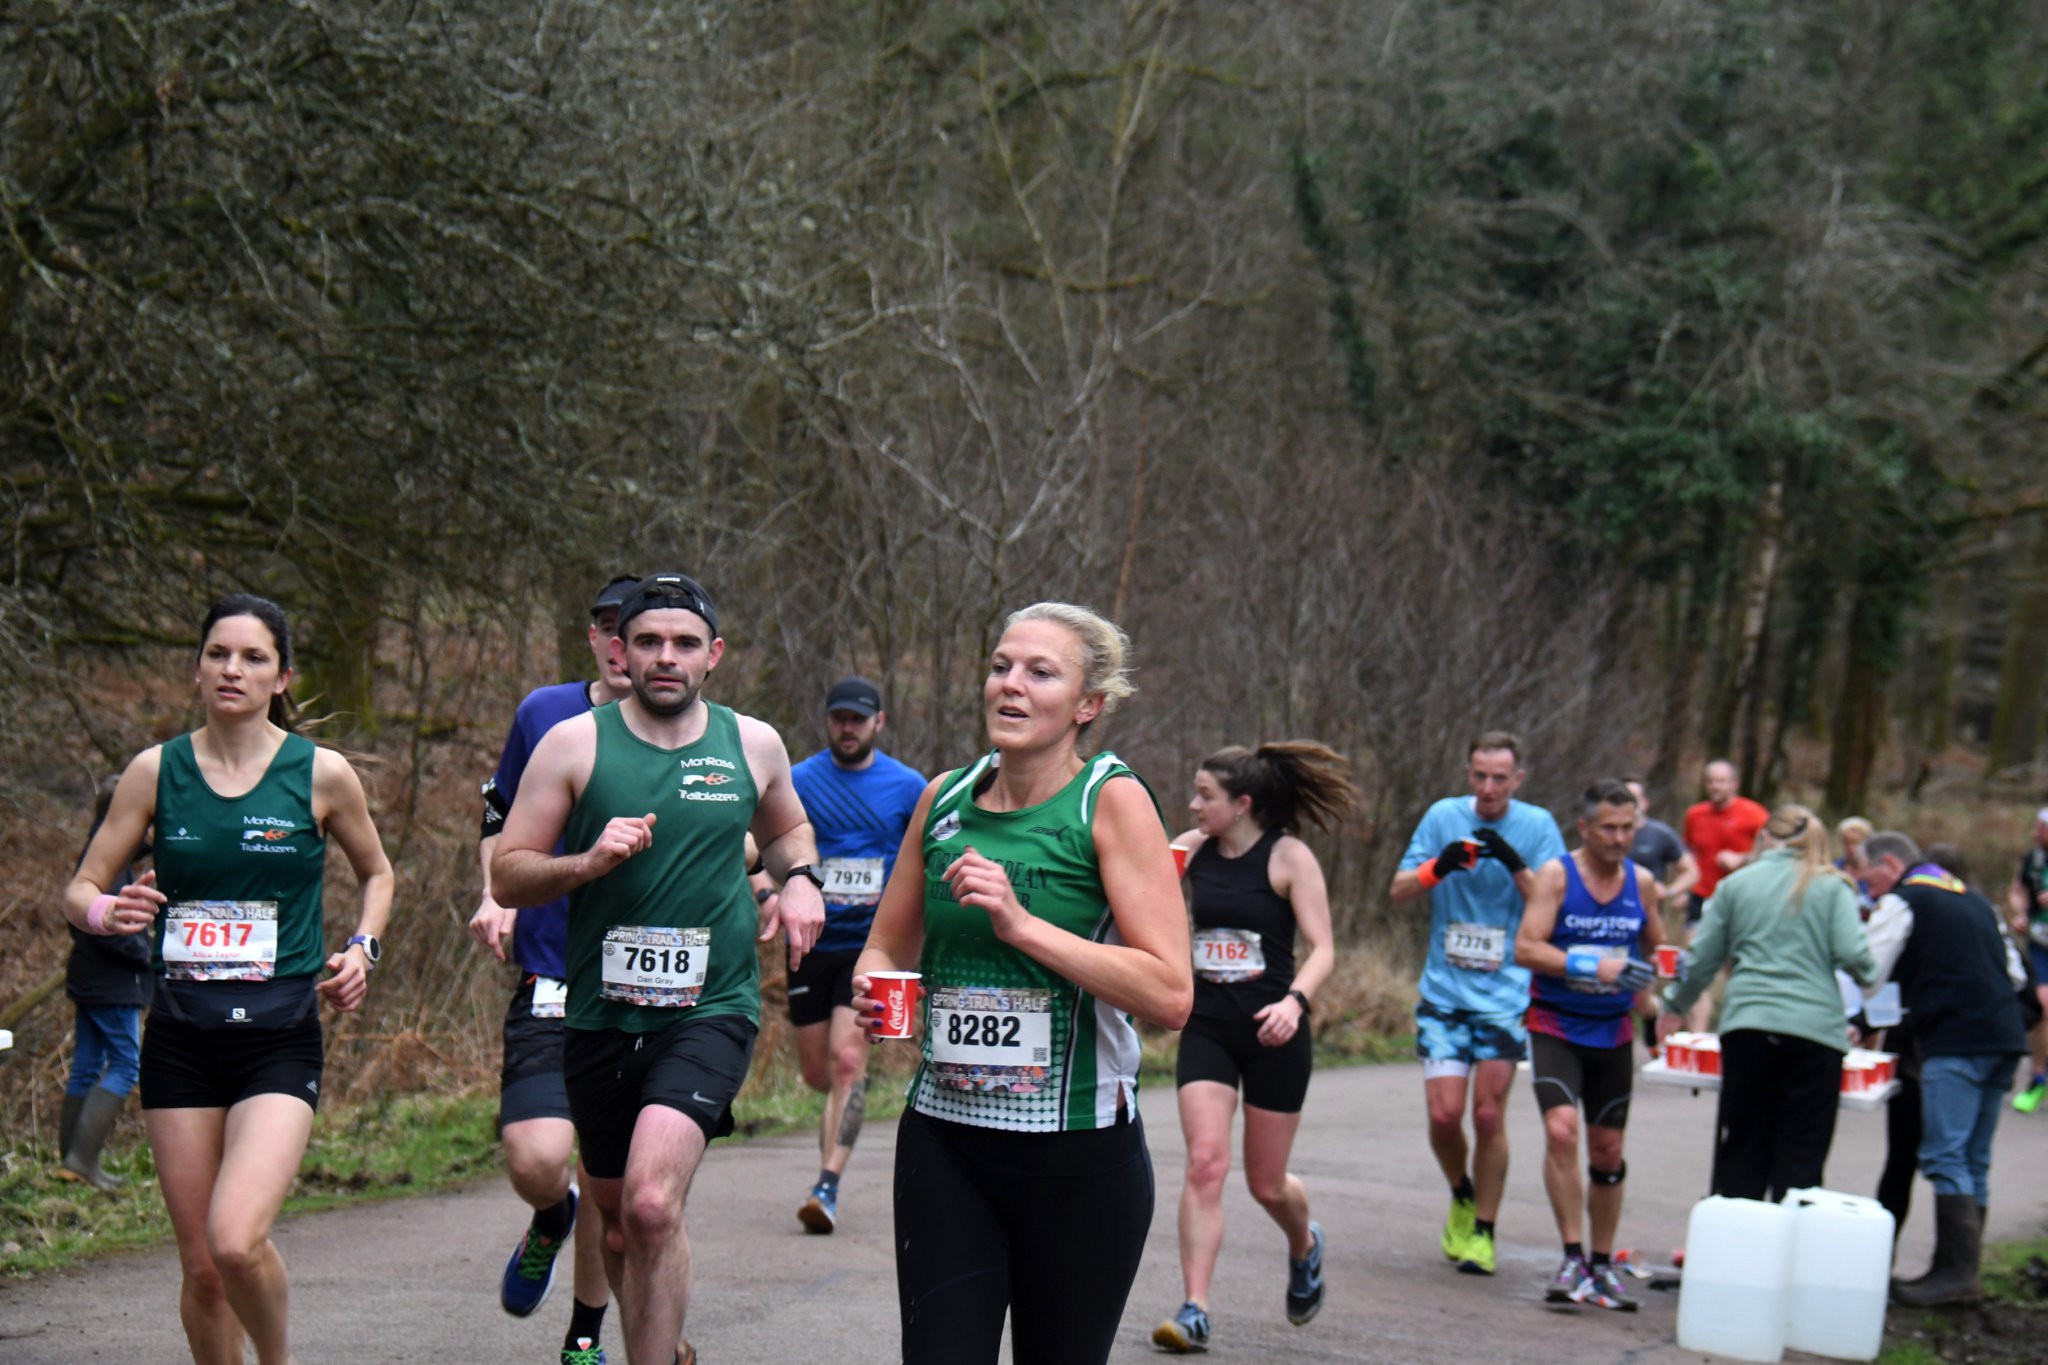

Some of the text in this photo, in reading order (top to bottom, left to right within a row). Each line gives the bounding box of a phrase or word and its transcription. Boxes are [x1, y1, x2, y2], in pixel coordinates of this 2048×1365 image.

[681, 756, 735, 769] MonRoss
[678, 789, 740, 801] Trailblazers
[243, 816, 295, 828] MonRoss
[240, 842, 297, 853] Trailblazers
[834, 870, 871, 885] 7976
[168, 907, 204, 918] SPRING
[245, 908, 277, 920] HALF
[183, 922, 253, 947] 7617
[606, 930, 643, 944] SPRING
[646, 934, 683, 946] TRAILS
[1454, 934, 1492, 950] 7376
[1204, 943, 1249, 960] 7162
[624, 946, 689, 974] 7618
[637, 975, 673, 986] Dan Gray
[932, 993, 1049, 1011] SPRING TRAILS HALF
[948, 1013, 1021, 1047] 8282
